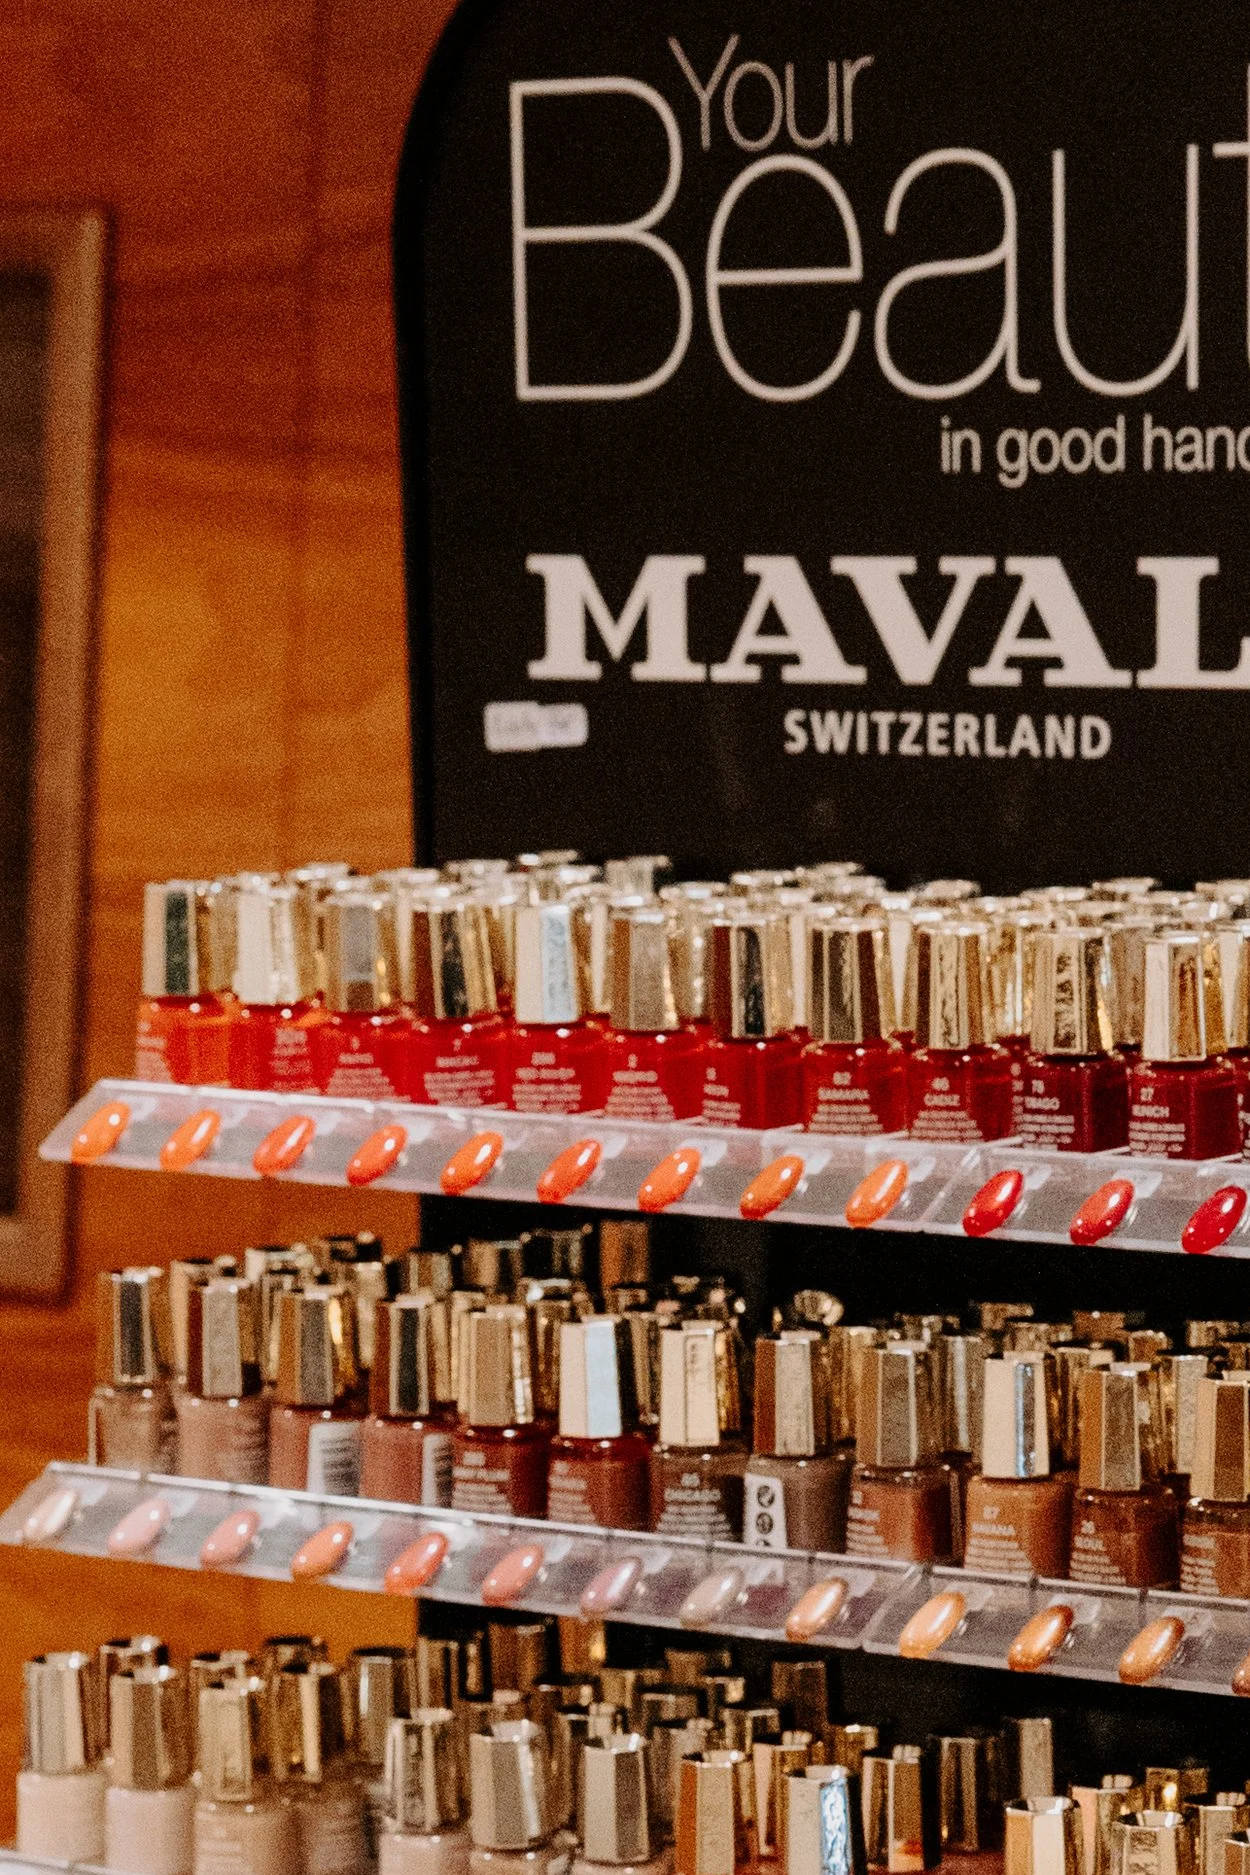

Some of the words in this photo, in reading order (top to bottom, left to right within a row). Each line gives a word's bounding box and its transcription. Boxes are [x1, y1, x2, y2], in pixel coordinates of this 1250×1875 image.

[668, 34, 874, 152] Your
[940, 417, 981, 473] in
[997, 413, 1126, 488] good
[783, 708, 1112, 759] SWITZERLAND
